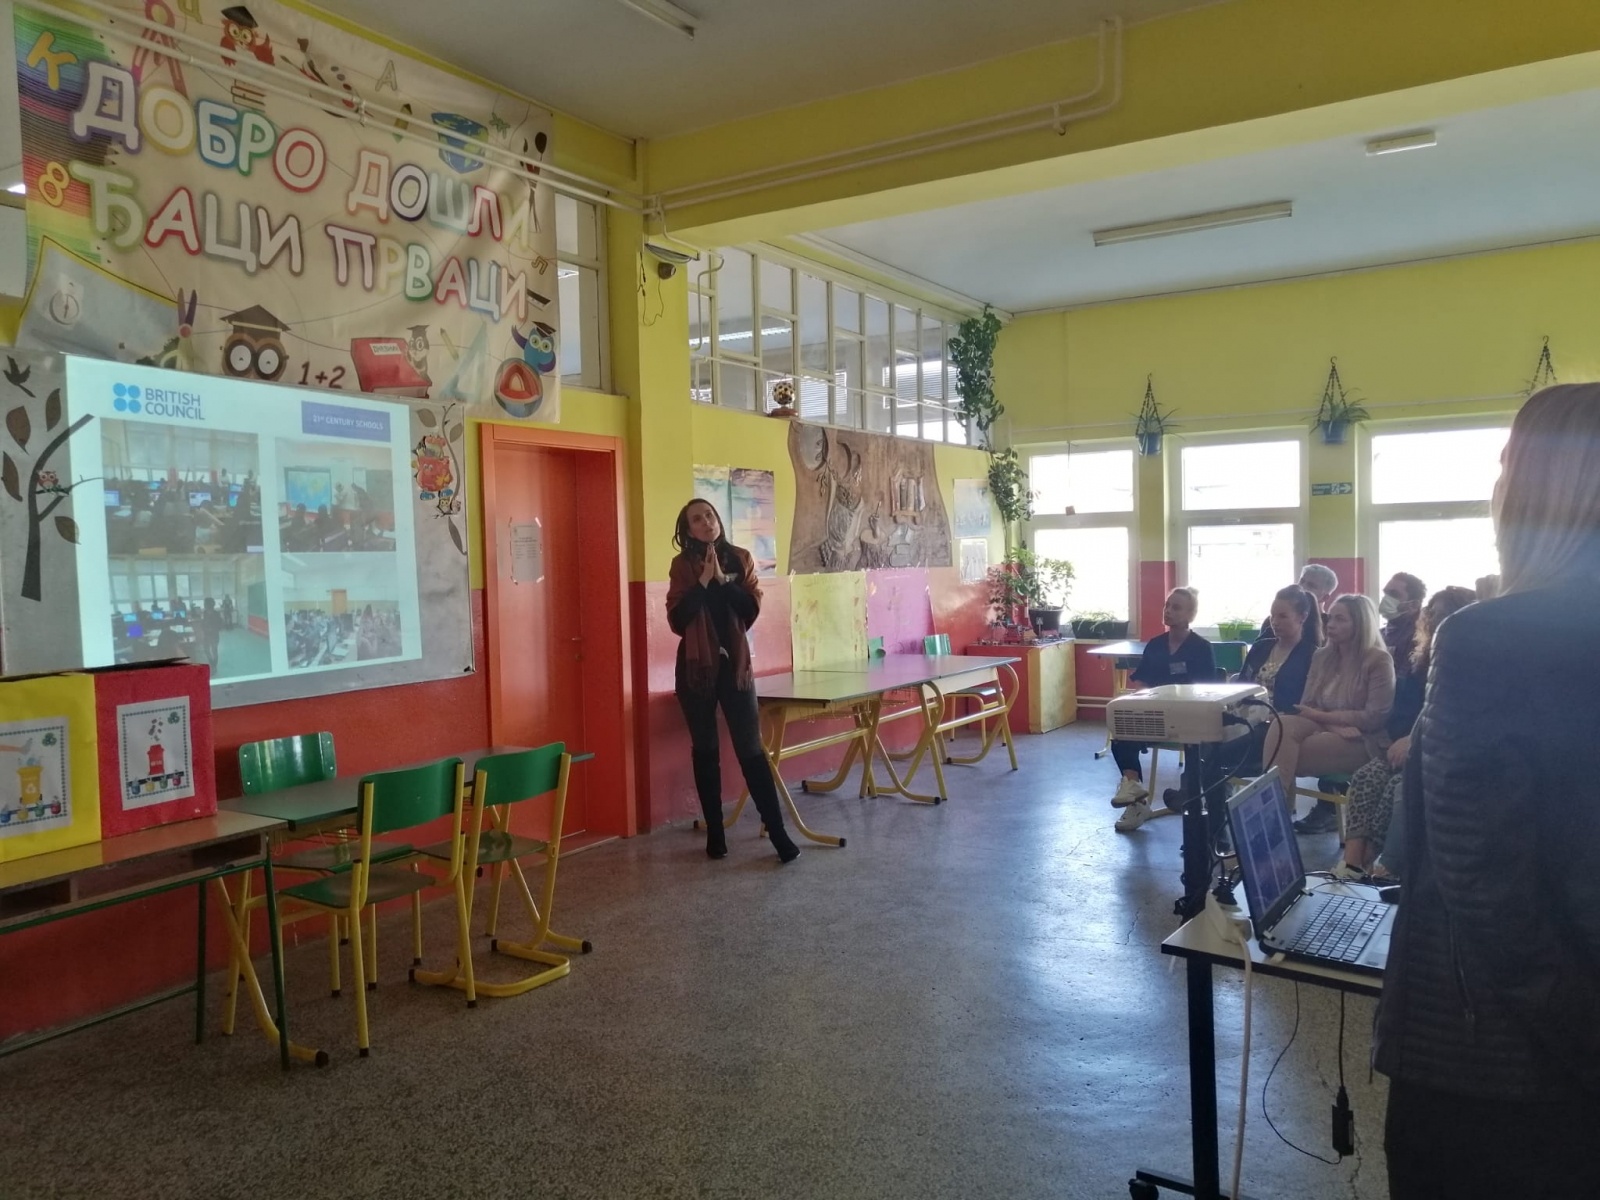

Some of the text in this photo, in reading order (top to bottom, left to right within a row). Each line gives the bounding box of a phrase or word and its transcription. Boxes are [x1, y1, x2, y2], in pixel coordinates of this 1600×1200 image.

[69, 58, 530, 250] ДОБРО ДОШЛИ
[38, 161, 70, 208] 8
[67, 158, 528, 323] ЂАЦИ ПРВАЦИ
[298, 361, 346, 389] 1+2
[145, 387, 201, 406] BRITISH
[145, 401, 205, 421] COUNCIL
[326, 416, 355, 427] CENTURY
[355, 419, 384, 431] SCHOOLS
